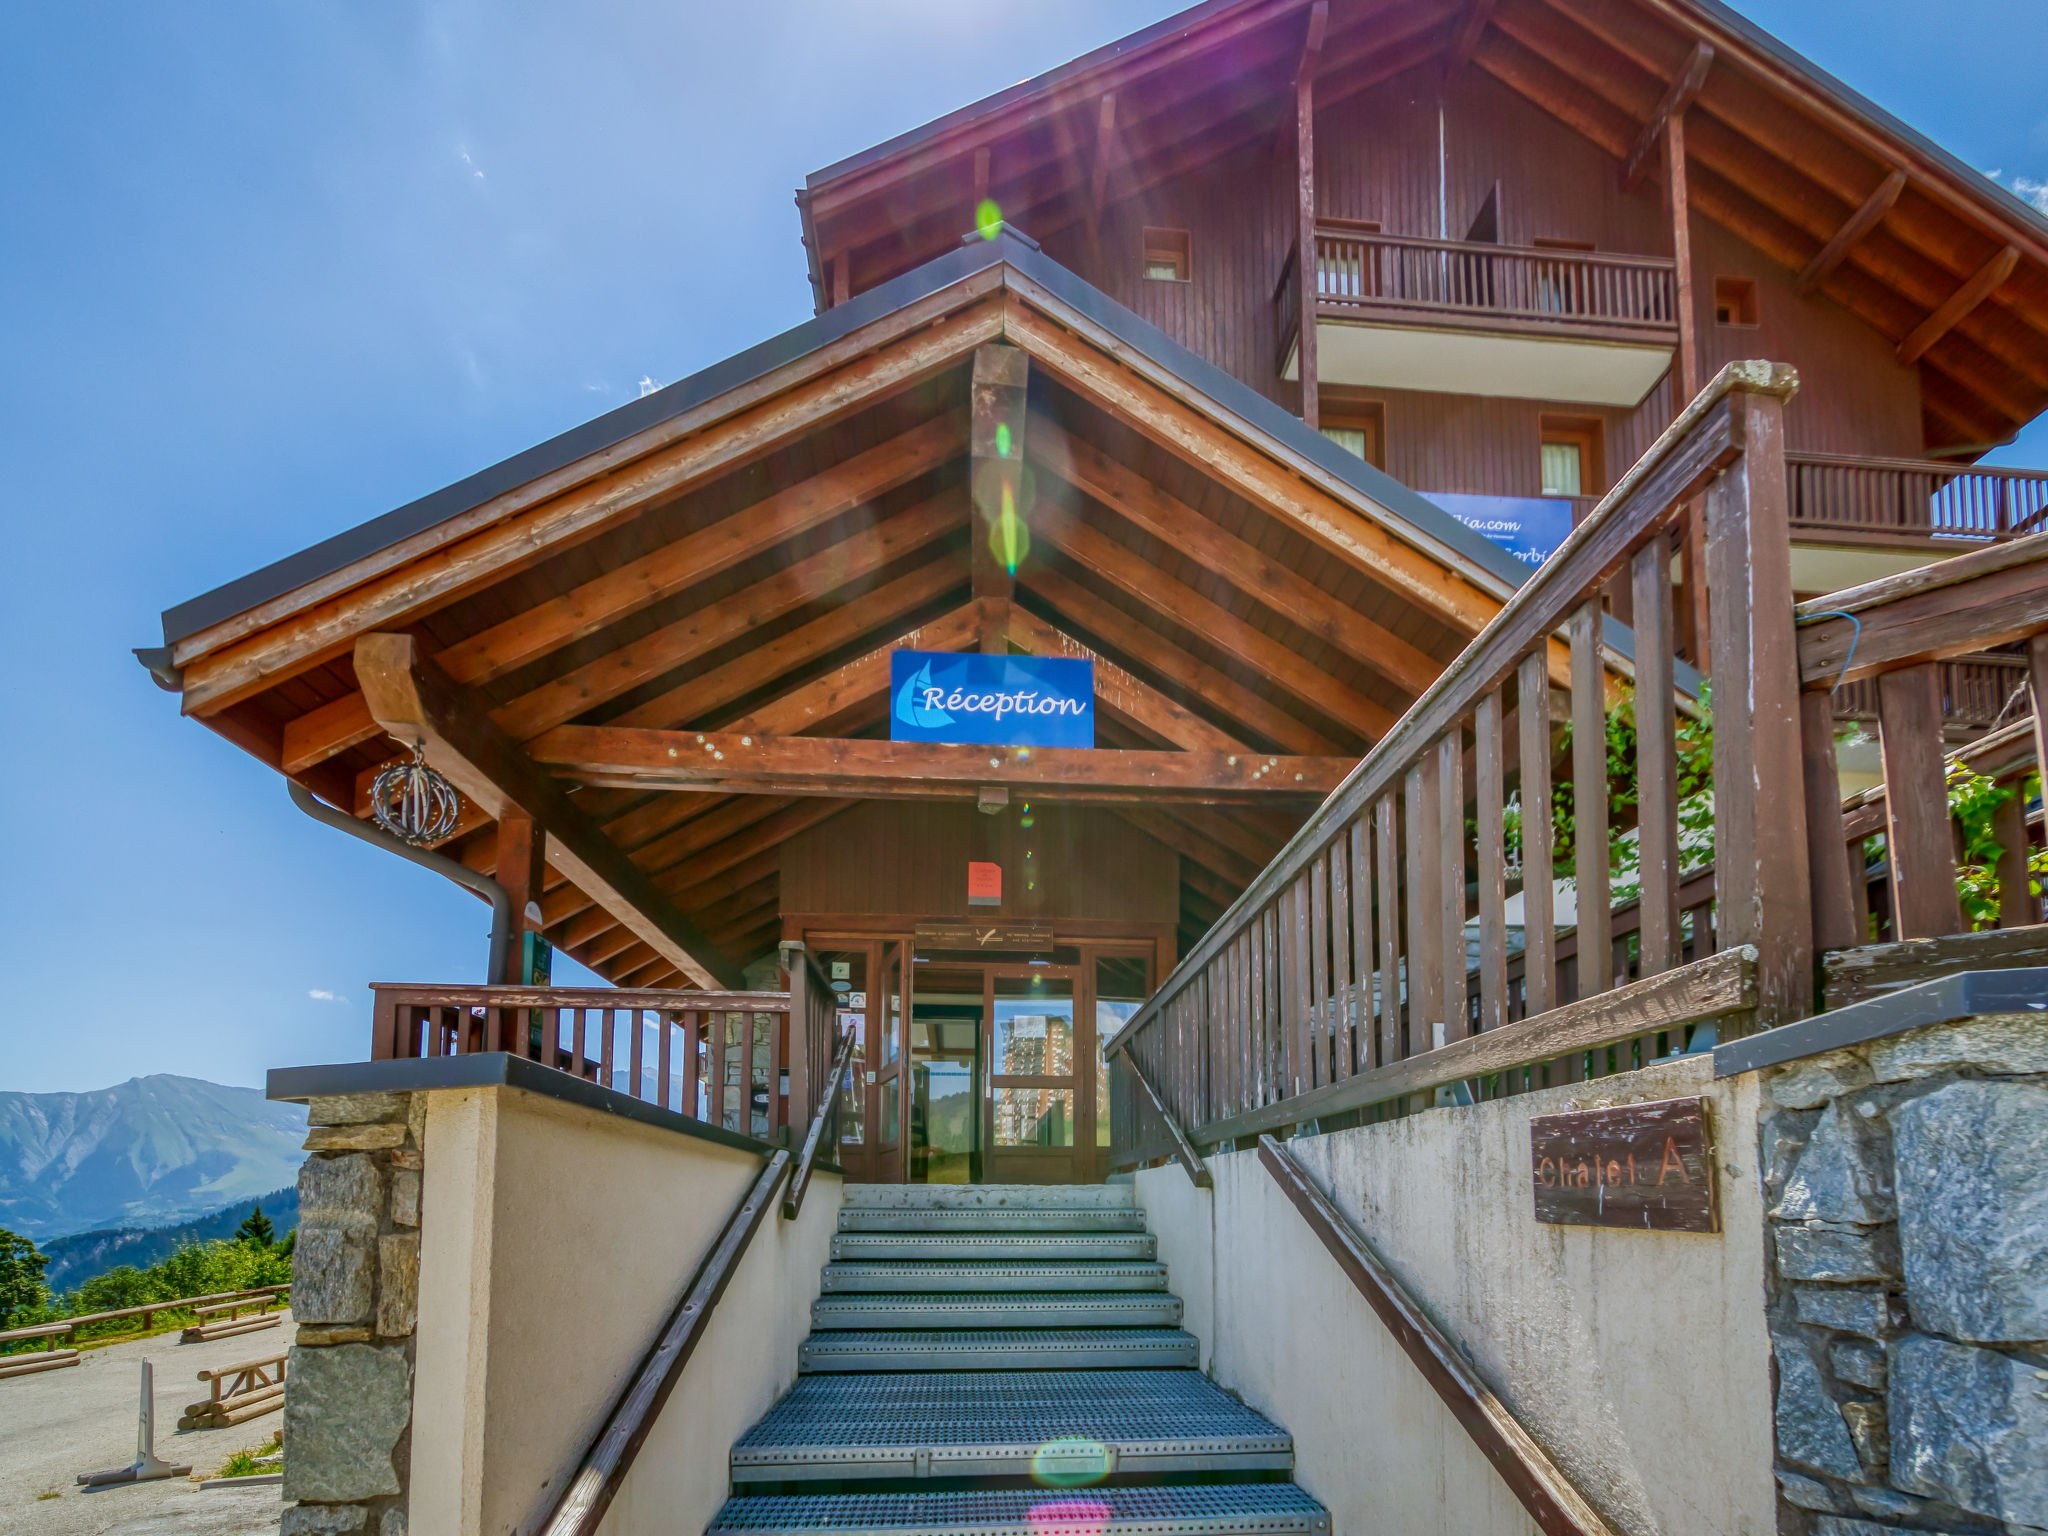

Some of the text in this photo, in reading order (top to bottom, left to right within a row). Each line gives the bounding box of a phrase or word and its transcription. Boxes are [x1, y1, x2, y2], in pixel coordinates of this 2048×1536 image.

[1505, 547, 1549, 563] orbi
[922, 687, 1087, 721] Réception
[1539, 1136, 1690, 1188] Chalet A
